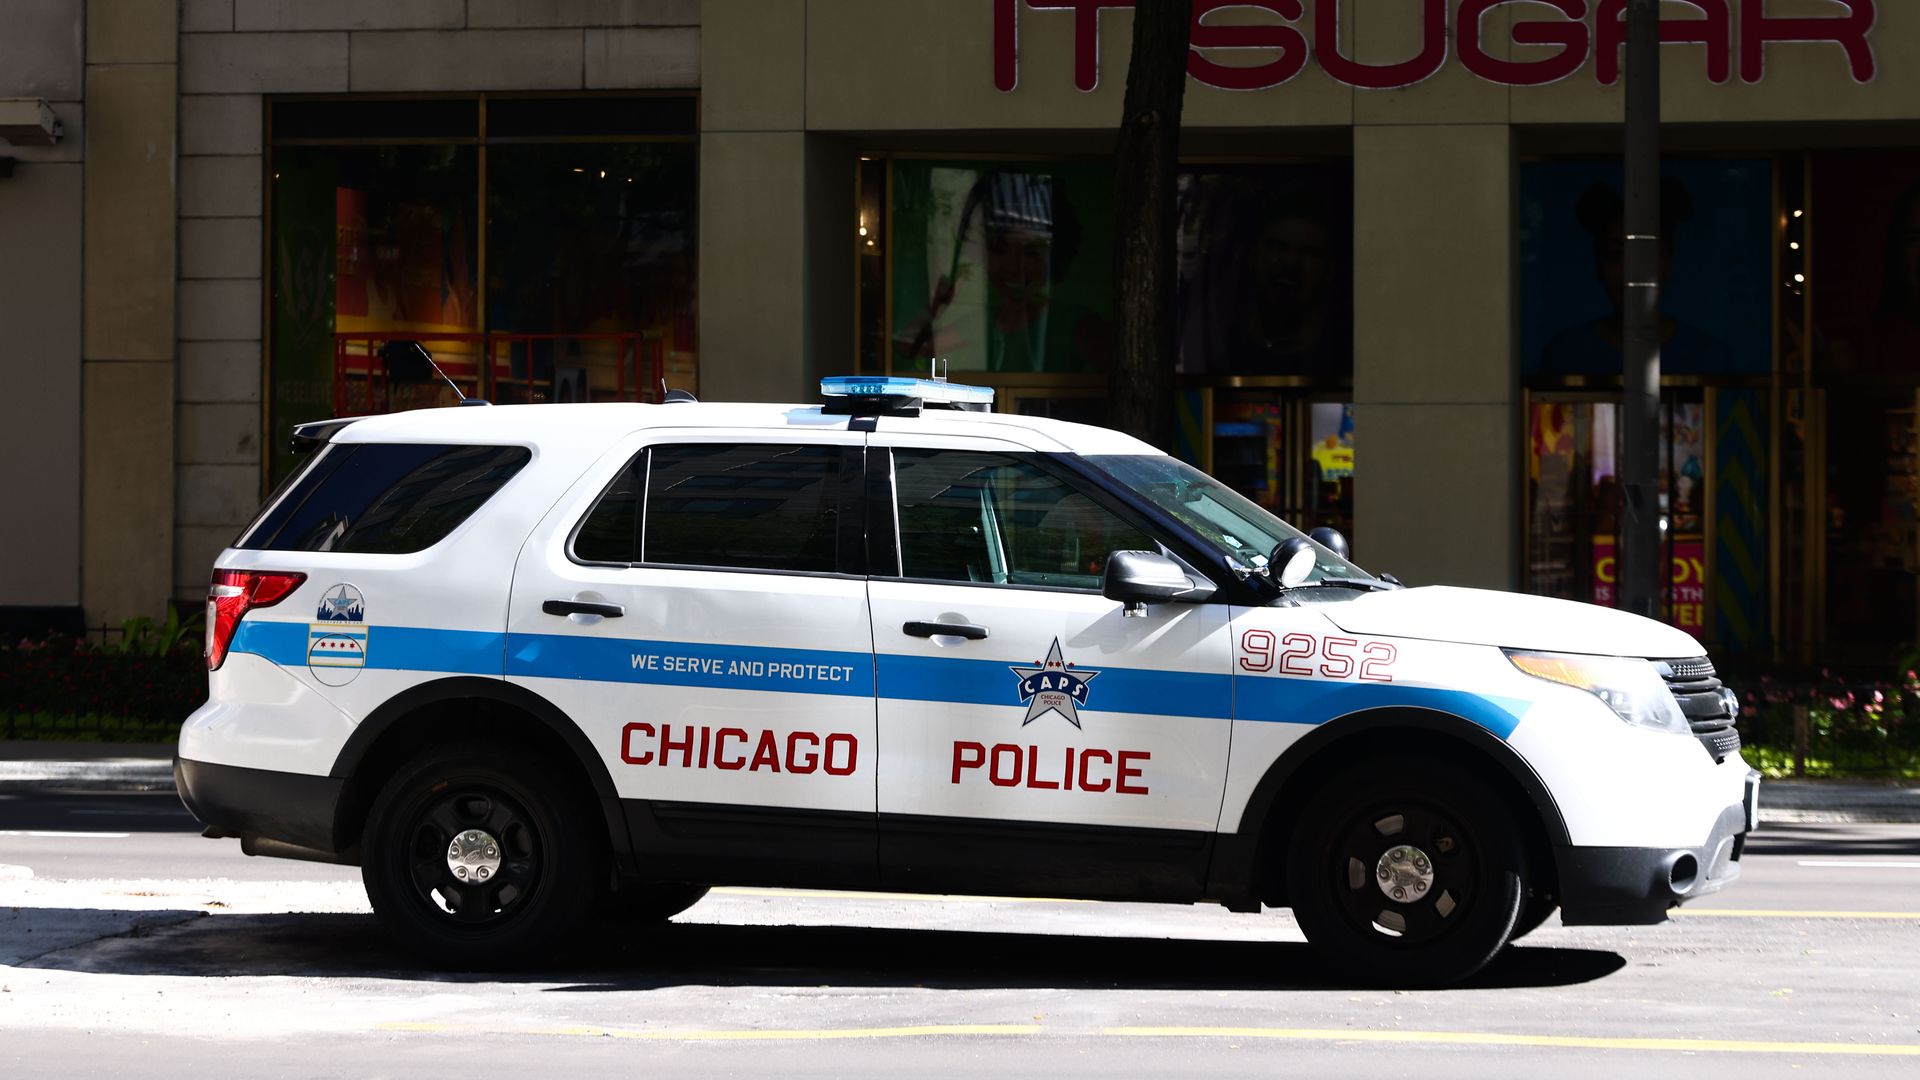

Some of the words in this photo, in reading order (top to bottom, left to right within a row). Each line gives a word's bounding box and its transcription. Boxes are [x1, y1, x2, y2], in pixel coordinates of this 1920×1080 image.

[1184, 0, 1876, 90] SUGAR
[1595, 587, 1611, 601] IS
[631, 654, 659, 671] WE
[663, 657, 724, 675] SERVE
[728, 661, 764, 677] AND
[768, 663, 854, 682] PROTECT
[1240, 629, 1397, 682] 9252
[1024, 676, 1084, 696] CAPS
[621, 721, 858, 776] CHICAGO
[951, 741, 1151, 795] POLICE
